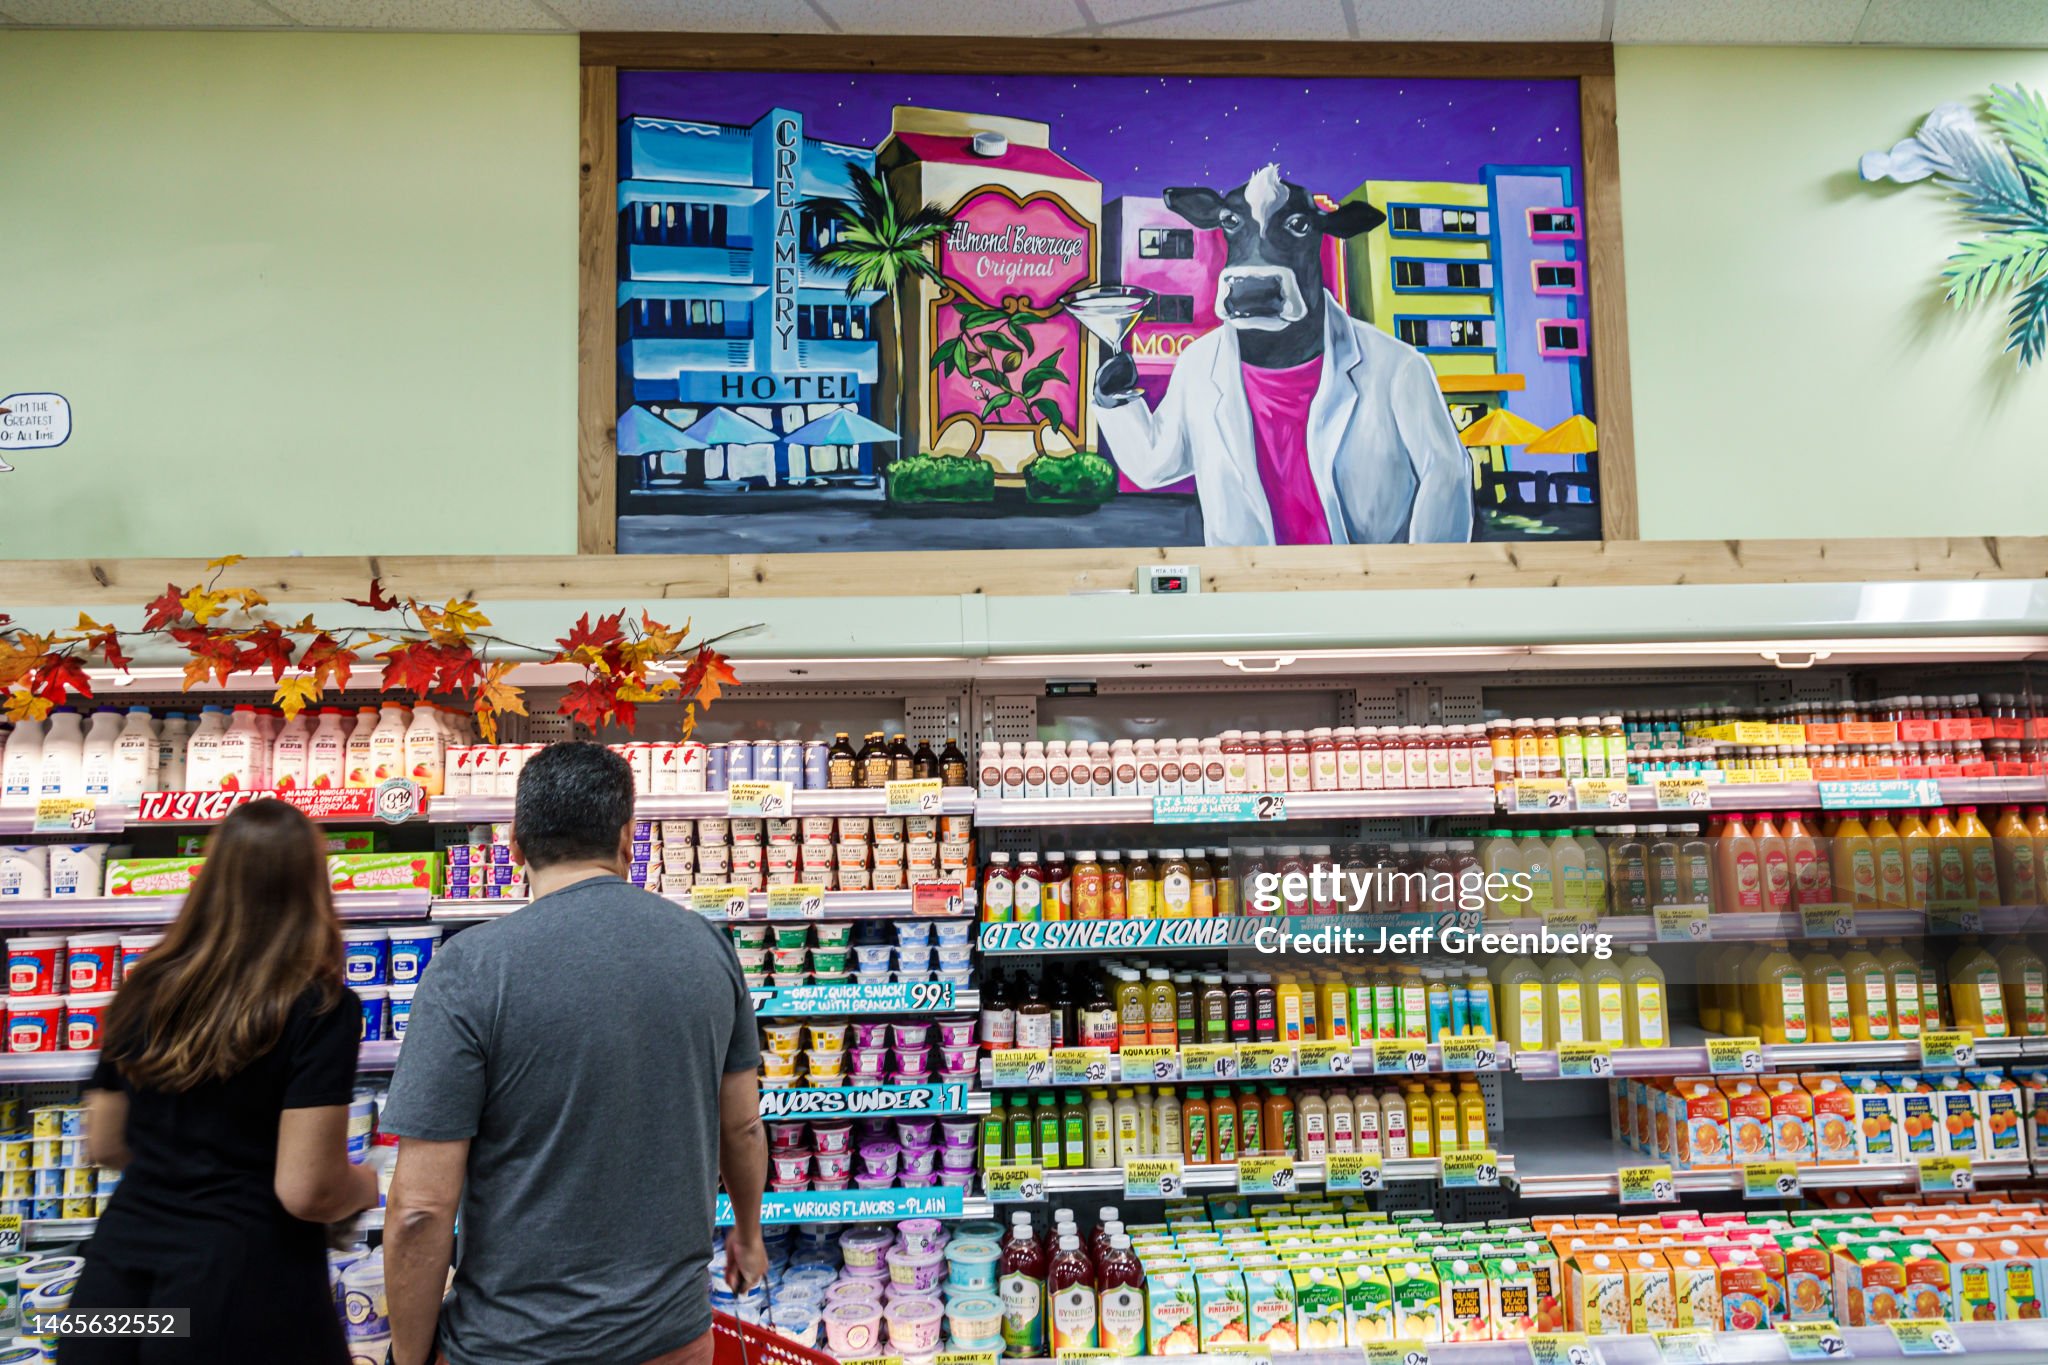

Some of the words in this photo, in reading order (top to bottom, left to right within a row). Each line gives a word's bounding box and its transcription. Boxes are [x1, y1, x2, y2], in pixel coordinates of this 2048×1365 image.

[775, 119, 799, 350] CREAMERY
[947, 221, 1010, 252] Almond
[1010, 225, 1083, 264] Beverage
[975, 255, 1055, 285] Original
[721, 375, 856, 400] HOTEL
[141, 792, 196, 820] TJ'S
[193, 790, 278, 820] KEF
[1210, 804, 1242, 813] WATER
[983, 922, 1040, 949] GT'S
[1043, 920, 1157, 948] SYNERGY
[1157, 915, 1292, 946] KOMBUCHA
[828, 985, 862, 998] QUICK
[864, 984, 907, 998] SNACK!
[818, 999, 852, 1011] WITH
[1145, 1048, 1170, 1056] KEFIR
[1449, 1052, 1469, 1060] JUICE
[759, 1091, 845, 1115] AVORS
[848, 1088, 932, 1112] UNDER
[1455, 1154, 1483, 1162] MANGO
[989, 1171, 1004, 1181] VERY
[1005, 1170, 1029, 1180] GREEN
[993, 1182, 1011, 1191] JUICE
[792, 1202, 841, 1217] VARIOUS
[843, 1200, 895, 1216] FLAVORS
[1351, 1293, 1387, 1301] LEMONADE
[1399, 1291, 1436, 1299] LEMONADE
[1453, 1291, 1479, 1300] ORANGE
[1501, 1289, 1527, 1299] ORANGE
[1303, 1296, 1339, 1305] LEMONADE
[1455, 1299, 1477, 1307] PEACH
[1504, 1298, 1525, 1306] PEACH
[1058, 1308, 1094, 1318] SYNERGY
[1106, 1308, 1142, 1318] SYNERGY
[1158, 1307, 1190, 1315] PINEAPPLE
[1208, 1306, 1241, 1314] PINEAPPLE
[1257, 1305, 1290, 1313] PINEAPPLE
[1454, 1306, 1479, 1315] MANGO
[1503, 1305, 1528, 1313] MANGO
[954, 1354, 980, 1362] LOWFAT
